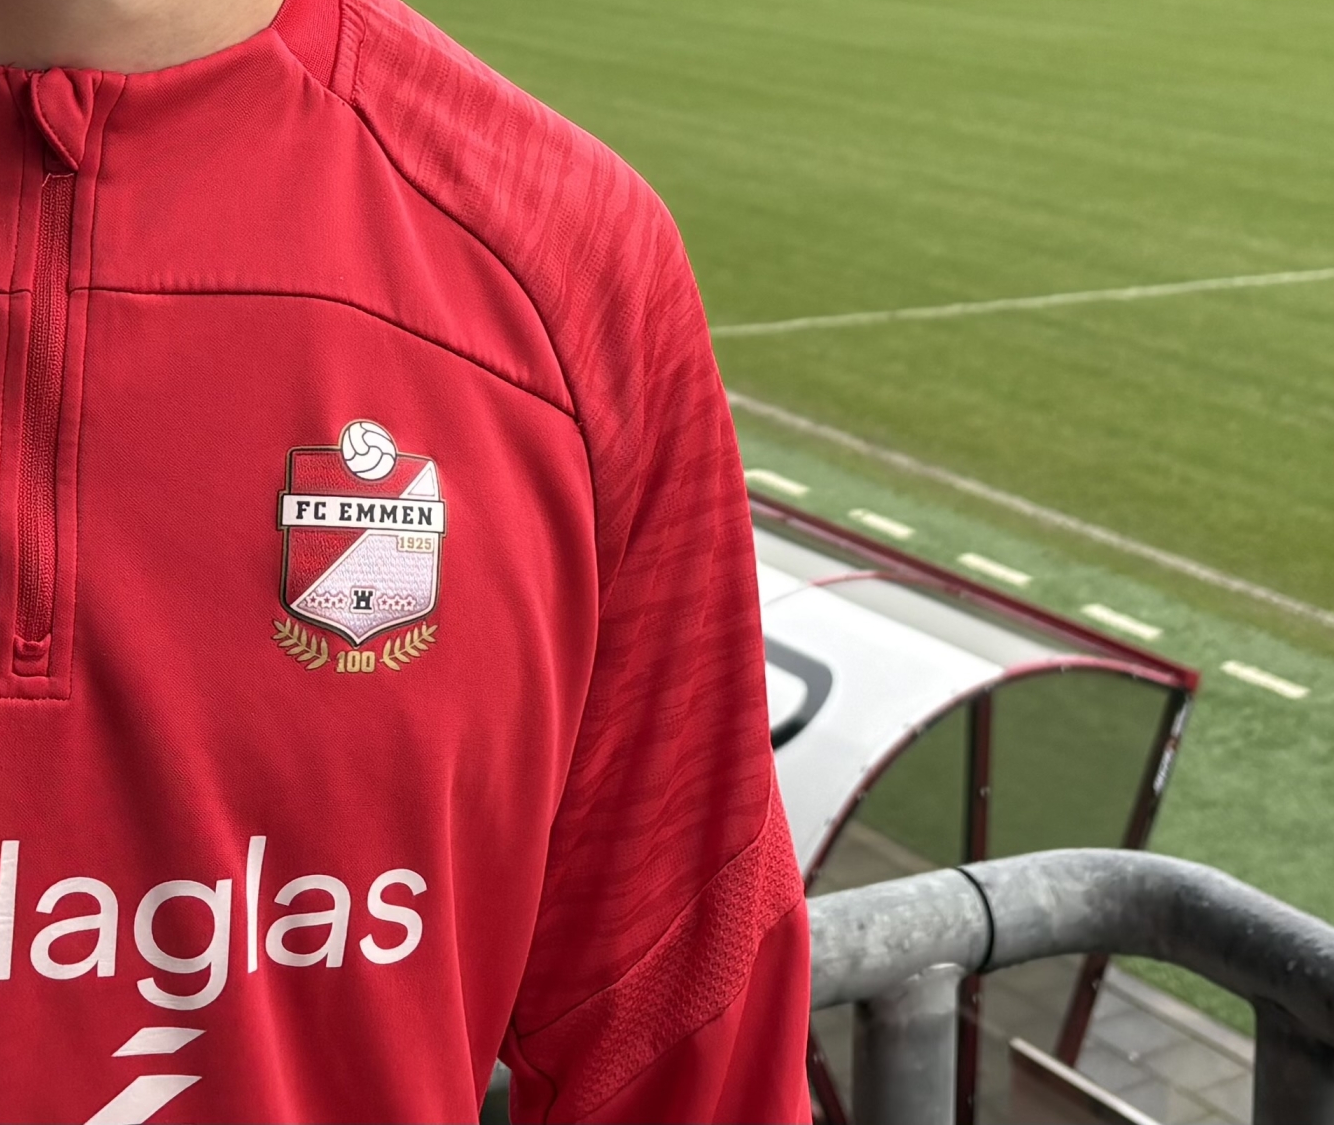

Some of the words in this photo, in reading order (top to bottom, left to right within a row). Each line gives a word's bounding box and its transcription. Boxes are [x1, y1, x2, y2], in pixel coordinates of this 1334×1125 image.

[295, 500, 327, 521] FC
[339, 502, 434, 526] EMMEN
[399, 535, 433, 551] 1925
[335, 651, 376, 673] 100
